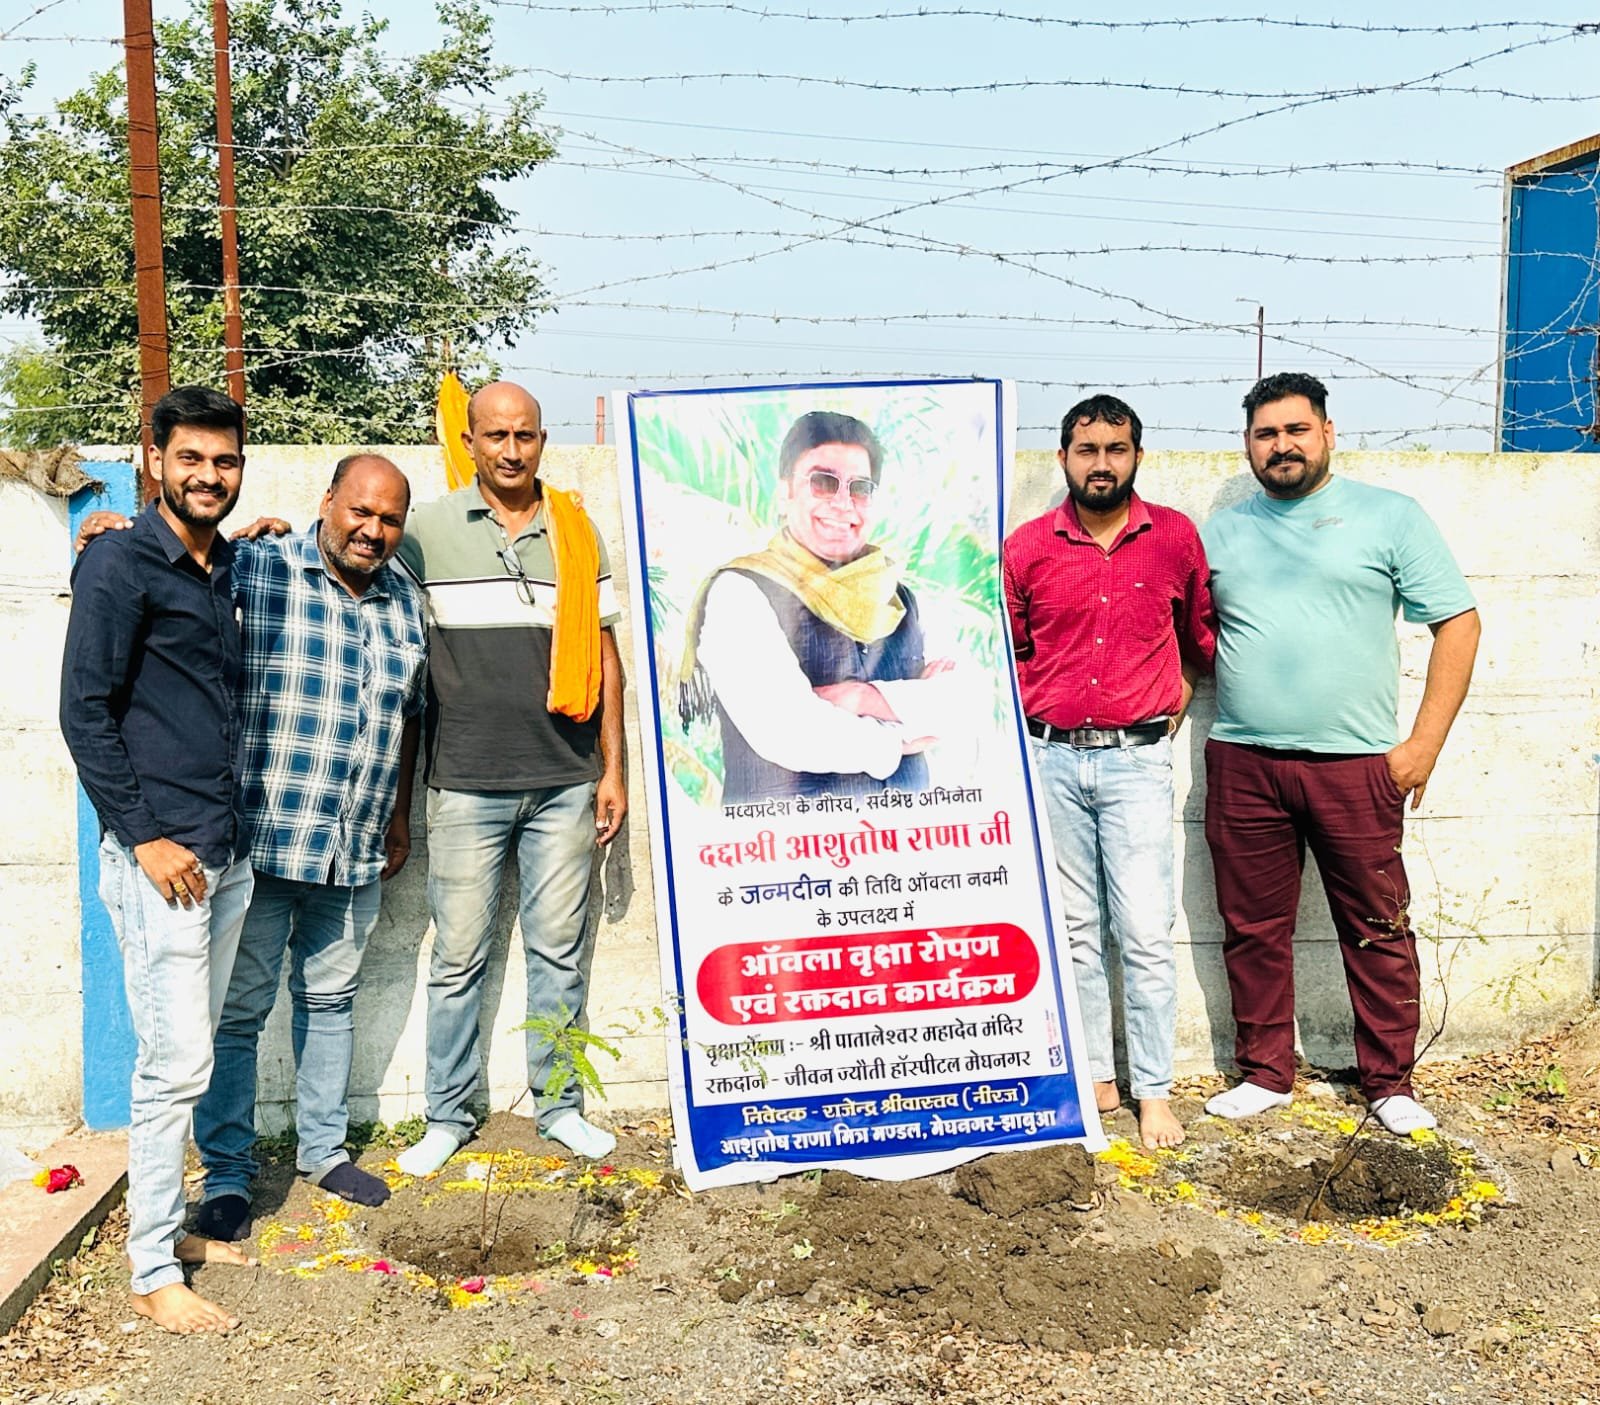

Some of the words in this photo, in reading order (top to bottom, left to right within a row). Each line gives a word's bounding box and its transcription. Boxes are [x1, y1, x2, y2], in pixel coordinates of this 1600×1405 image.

[725, 799, 791, 819] मध्यप्रदेश
[796, 795, 810, 814] के
[816, 792, 860, 813] गौरव,
[867, 790, 913, 809] सर्वश्रेष्ठ
[919, 786, 982, 806] अभिनेता
[786, 820, 898, 868] आशुतोष
[906, 823, 971, 851] राणा
[979, 810, 1011, 846] जी
[718, 886, 733, 906] के
[739, 873, 832, 904] जन्मदीन
[838, 876, 859, 897] की
[866, 873, 902, 895] तिथि
[967, 865, 1008, 887] नवमी
[816, 908, 832, 927] के
[837, 907, 898, 926] उपलक्ष्य
[903, 900, 914, 921] में
[848, 942, 913, 977] वृक्षा
[917, 931, 1000, 963] रोपण
[730, 983, 777, 1023] एवं
[783, 983, 888, 1013] रक्तदान
[892, 968, 1016, 1004] कार्यक्रम
[809, 1028, 831, 1051] श्री
[835, 1024, 917, 1048] पातालेश्वर
[922, 1018, 978, 1042] महादेव
[982, 1013, 1024, 1037] मंदिर
[784, 1064, 833, 1087] जीवन
[838, 1058, 886, 1082] ज्यौती
[890, 1053, 961, 1079] हॉस्पीटल
[965, 1050, 1031, 1071] मेघनगर
[742, 1105, 807, 1126] निवेदक
[823, 1097, 879, 1119] राजेन्द्र
[880, 1093, 959, 1115] श्रीवास्तव
[720, 1130, 790, 1158] आशुतोष
[792, 1131, 832, 1149] राणा
[834, 1123, 869, 1146] मित्र
